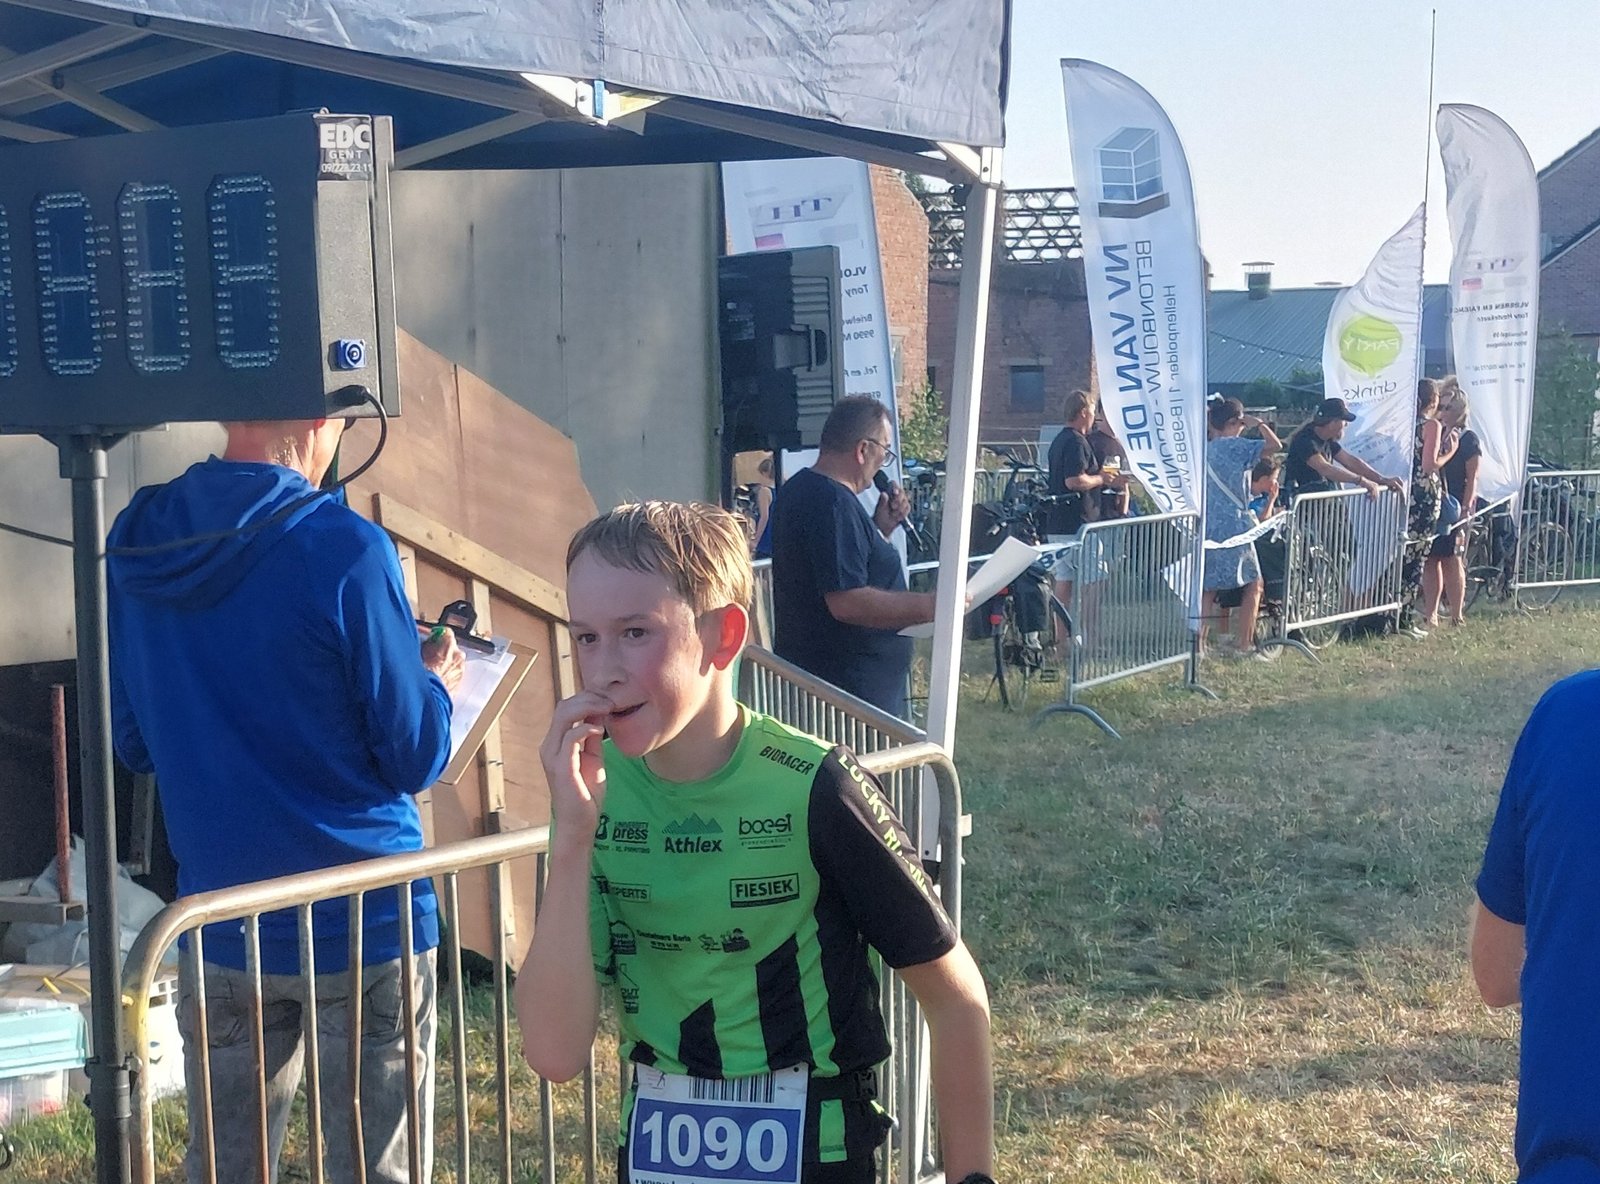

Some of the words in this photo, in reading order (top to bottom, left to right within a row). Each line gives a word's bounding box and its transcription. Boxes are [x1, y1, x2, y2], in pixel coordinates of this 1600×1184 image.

[320, 123, 371, 150] EDC
[328, 150, 363, 159] GENT
[760, 745, 815, 776] BIORACER
[838, 754, 890, 825] LUCKY
[612, 827, 649, 842] press
[664, 836, 723, 854] Athlex
[735, 879, 794, 898] FIESIEK
[641, 1110, 788, 1173] 1090
